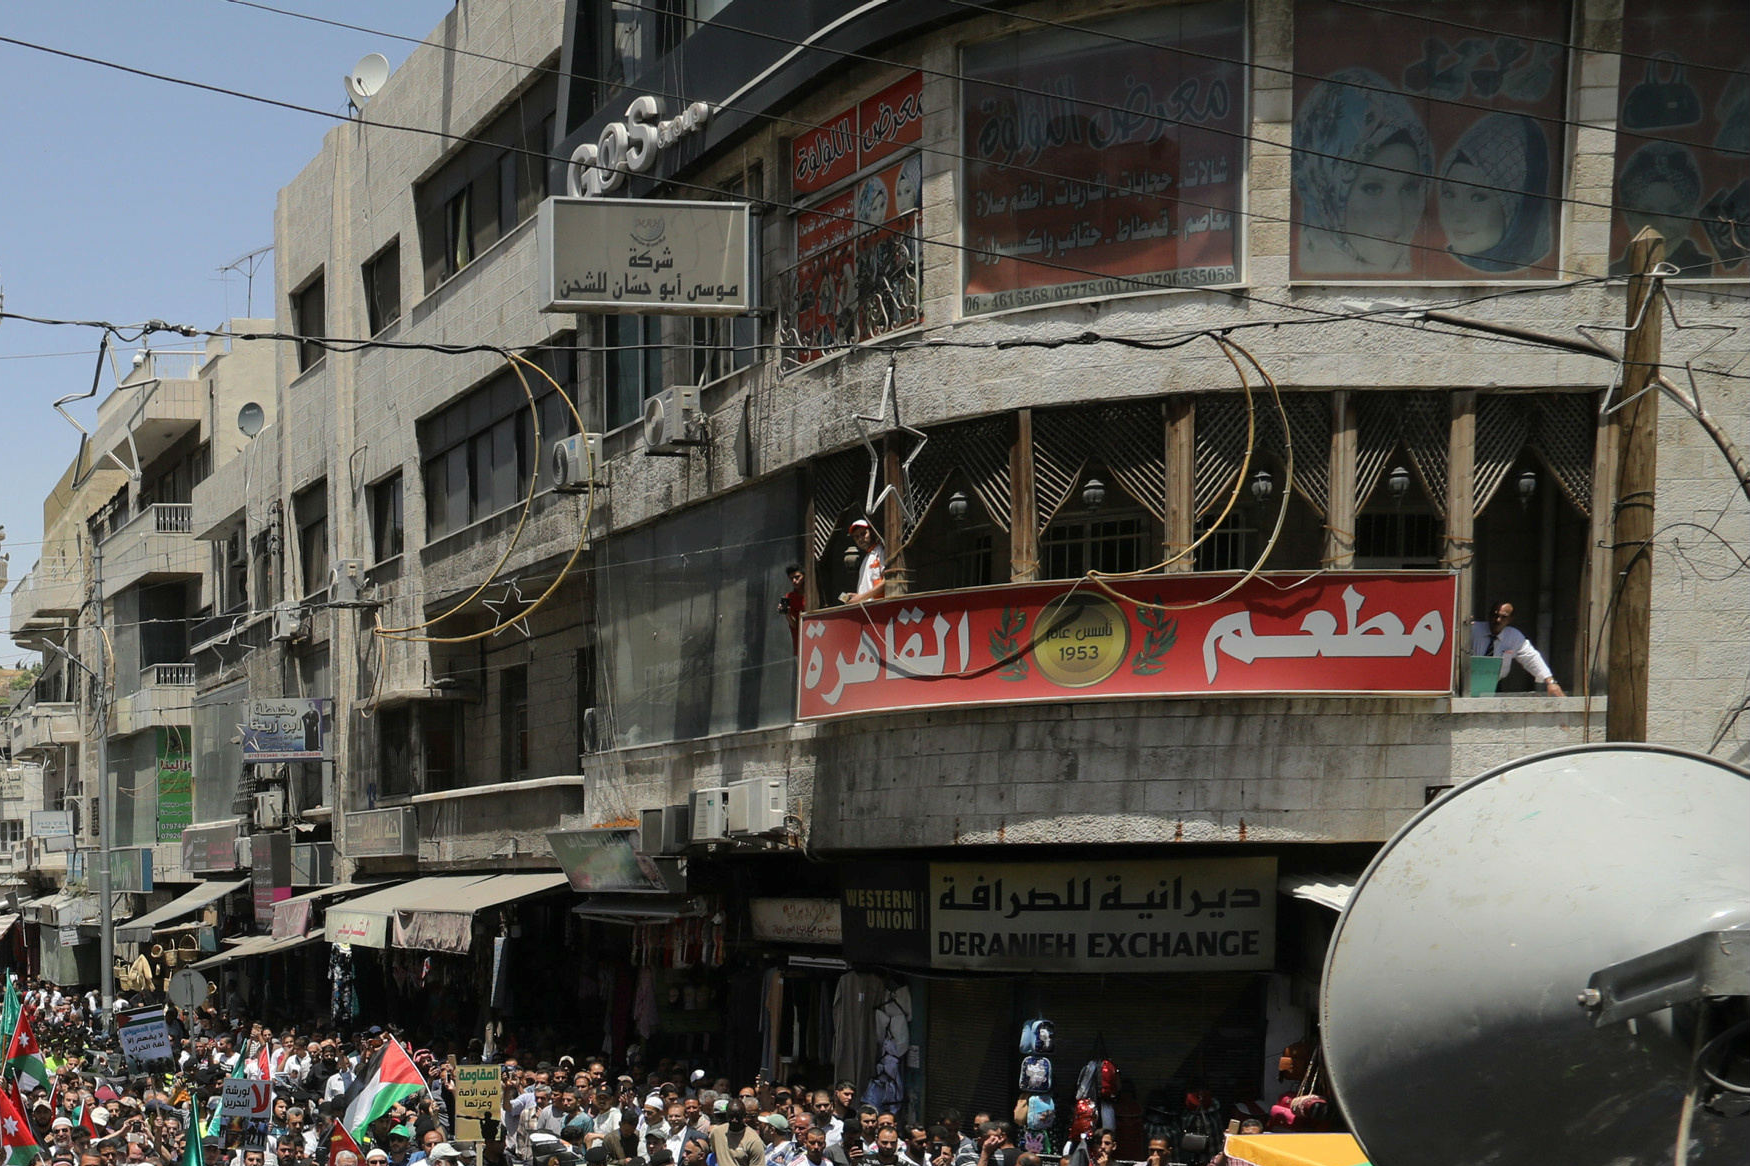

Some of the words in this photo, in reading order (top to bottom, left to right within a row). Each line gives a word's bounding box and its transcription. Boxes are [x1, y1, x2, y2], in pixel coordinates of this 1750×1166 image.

[629, 247, 673, 273] شركة
[560, 271, 608, 298] للشحن
[659, 273, 682, 300] أبو
[687, 283, 739, 302] موسى
[1204, 583, 1446, 685] مطعم
[805, 603, 971, 706] القاهرة
[1059, 645, 1099, 661] 1953
[845, 889, 913, 910] WESTERN
[937, 874, 1091, 920] للصرافة
[1099, 872, 1261, 920] ديرانية
[866, 909, 913, 930] UNION
[937, 929, 1077, 959] DERANIEH
[1086, 929, 1260, 959] EXCHANGE
[459, 1068, 499, 1085] المقاومة
[251, 1083, 271, 1114] لا
[464, 1099, 493, 1110] وعزتها
[479, 1086, 498, 1098] شرف
